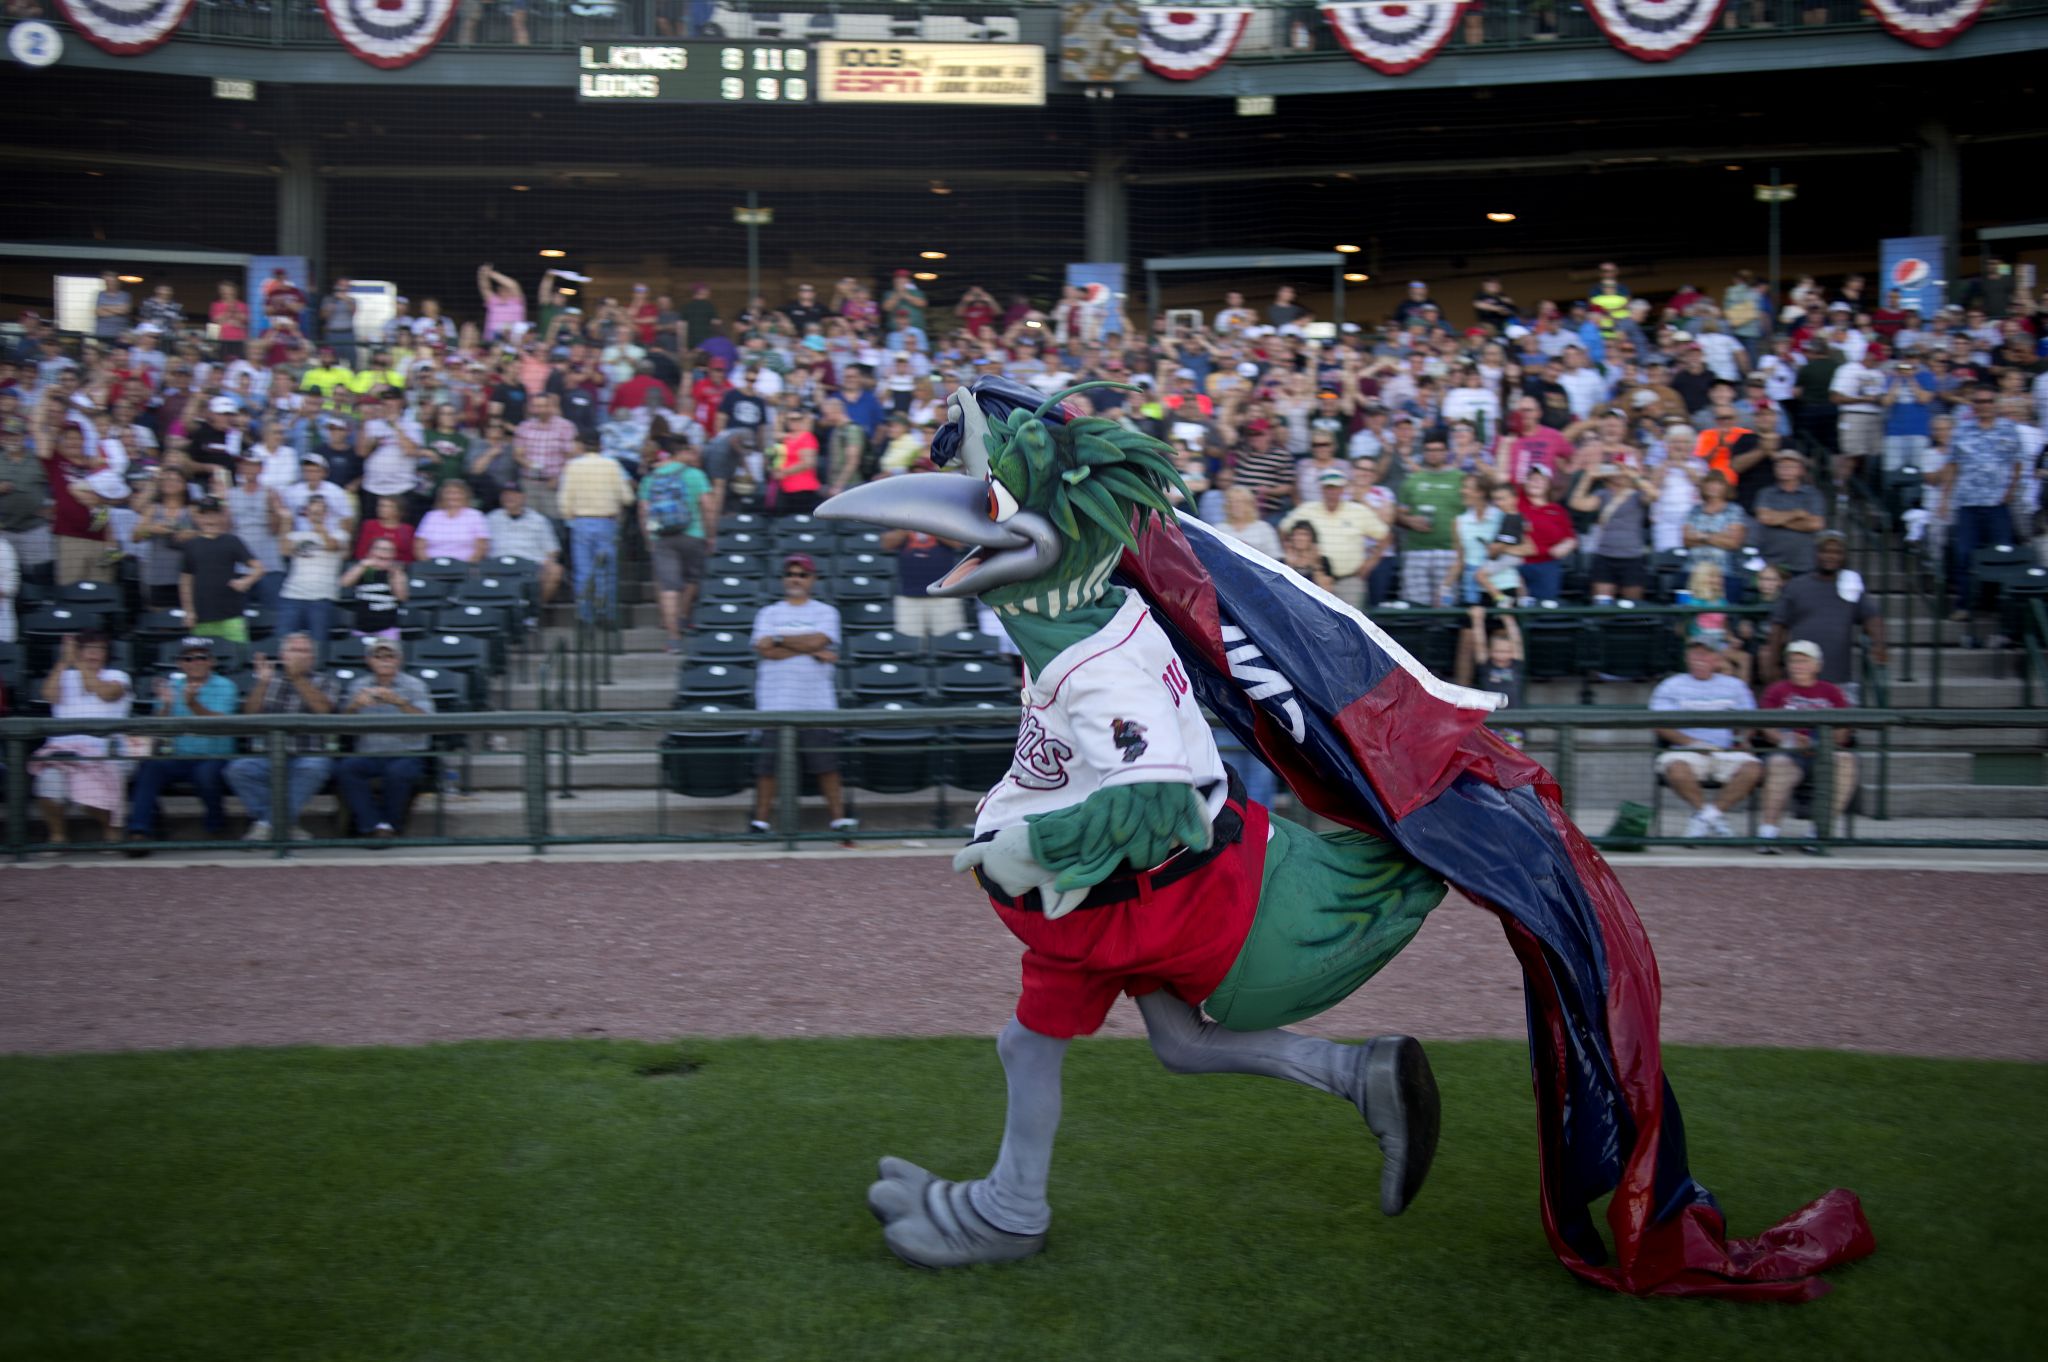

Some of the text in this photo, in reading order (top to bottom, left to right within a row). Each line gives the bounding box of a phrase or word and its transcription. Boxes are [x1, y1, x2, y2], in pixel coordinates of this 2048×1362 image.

[23, 31, 48, 57] 2
[721, 48, 744, 71] 8
[752, 48, 784, 71] 11
[785, 48, 808, 71] 0
[579, 74, 808, 101] LOONS 9 9 0
[833, 70, 922, 93] ESPN
